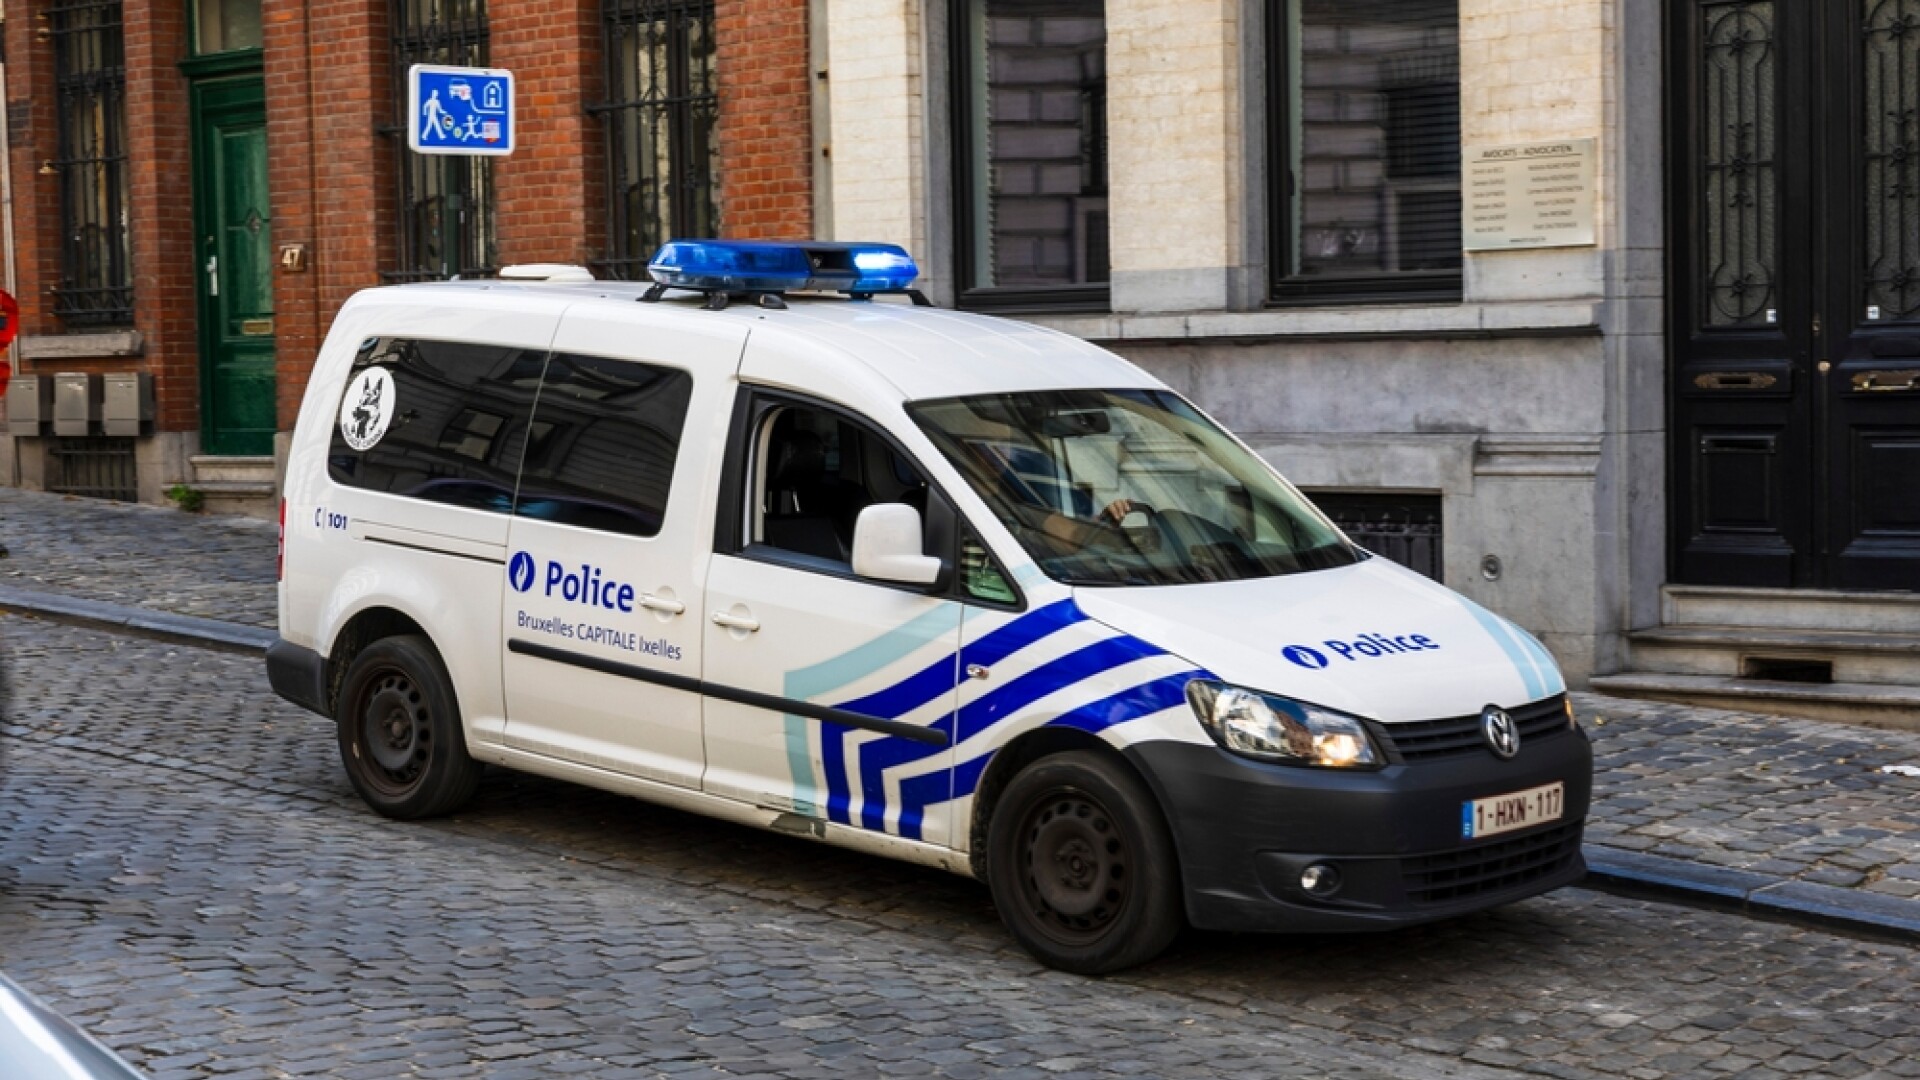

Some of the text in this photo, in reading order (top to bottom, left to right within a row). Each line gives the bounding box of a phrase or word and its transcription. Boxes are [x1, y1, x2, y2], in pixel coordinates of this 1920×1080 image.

[1482, 148, 1517, 158] AVOCATS
[1524, 144, 1572, 155] ADVOCATEN
[281, 248, 300, 268] 47
[327, 512, 348, 530] 101
[545, 560, 635, 613] Police
[517, 610, 682, 661] Bruxelles CAPITALE Ixelles
[1323, 632, 1441, 661] Police
[1477, 788, 1560, 831] 1-HXN-117
